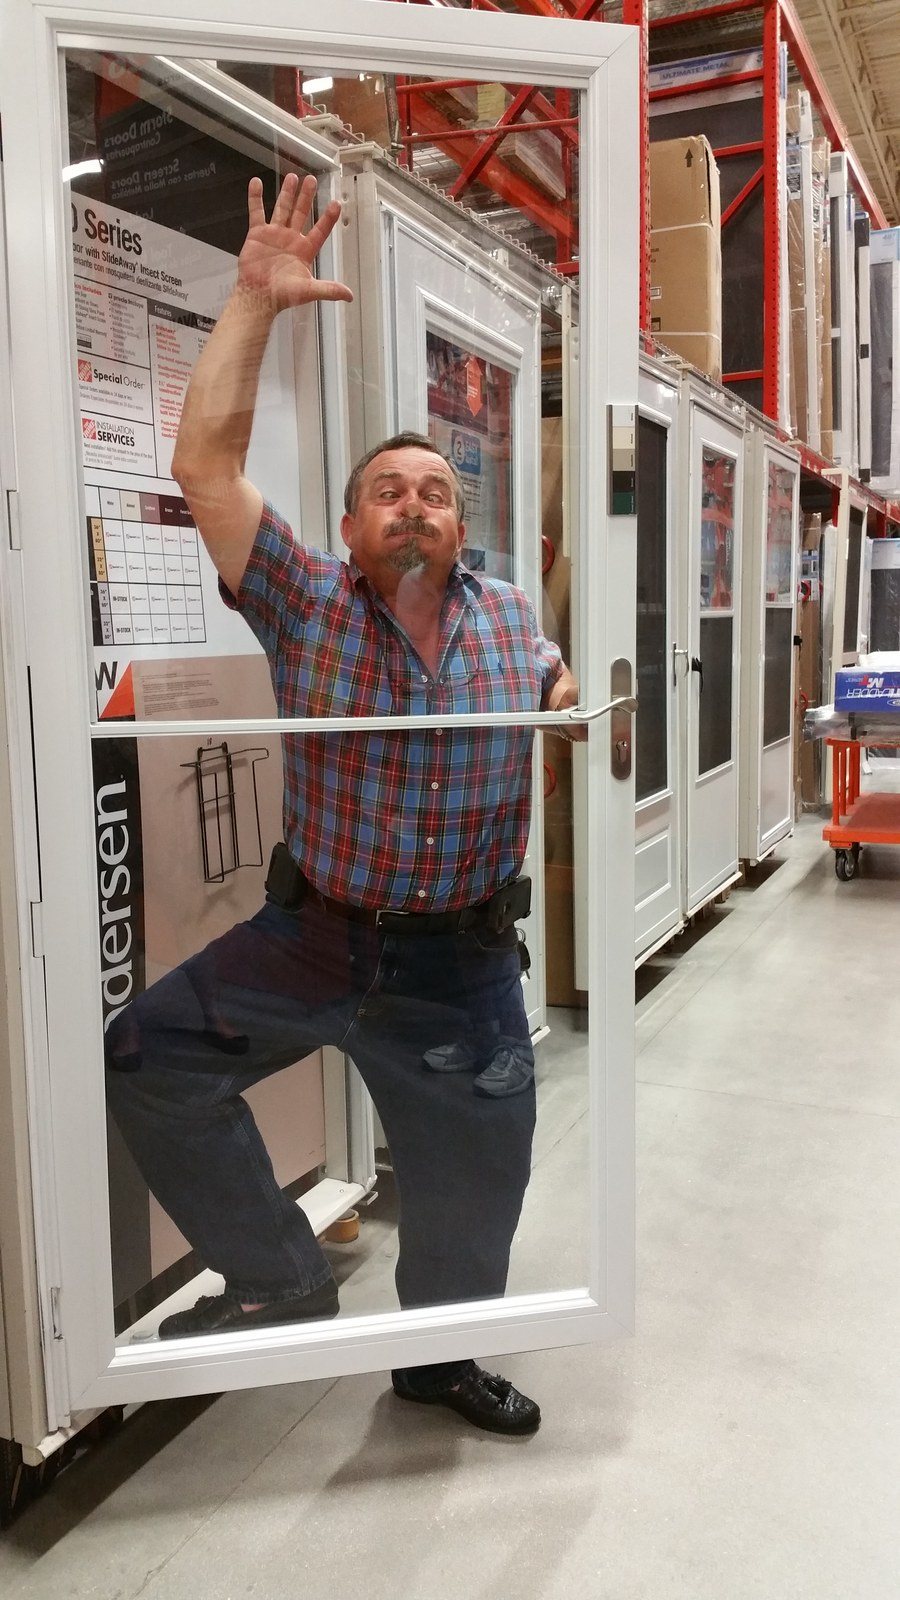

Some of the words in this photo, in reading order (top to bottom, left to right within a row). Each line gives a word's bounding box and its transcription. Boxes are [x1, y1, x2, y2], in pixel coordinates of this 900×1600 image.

[663, 68, 701, 80] ULTIMATE
[703, 62, 729, 72] METAL
[84, 209, 142, 256] Series
[85, 246, 100, 259] with
[140, 264, 159, 279] Insect
[161, 271, 182, 287] Screen
[94, 264, 104, 273] con
[154, 305, 172, 317] Features
[93, 369, 122, 384] Special
[124, 376, 143, 389] Order
[96, 421, 134, 435] INSTALLATION
[97, 430, 135, 447] SERVICES
[96, 779, 133, 1032] dersen
